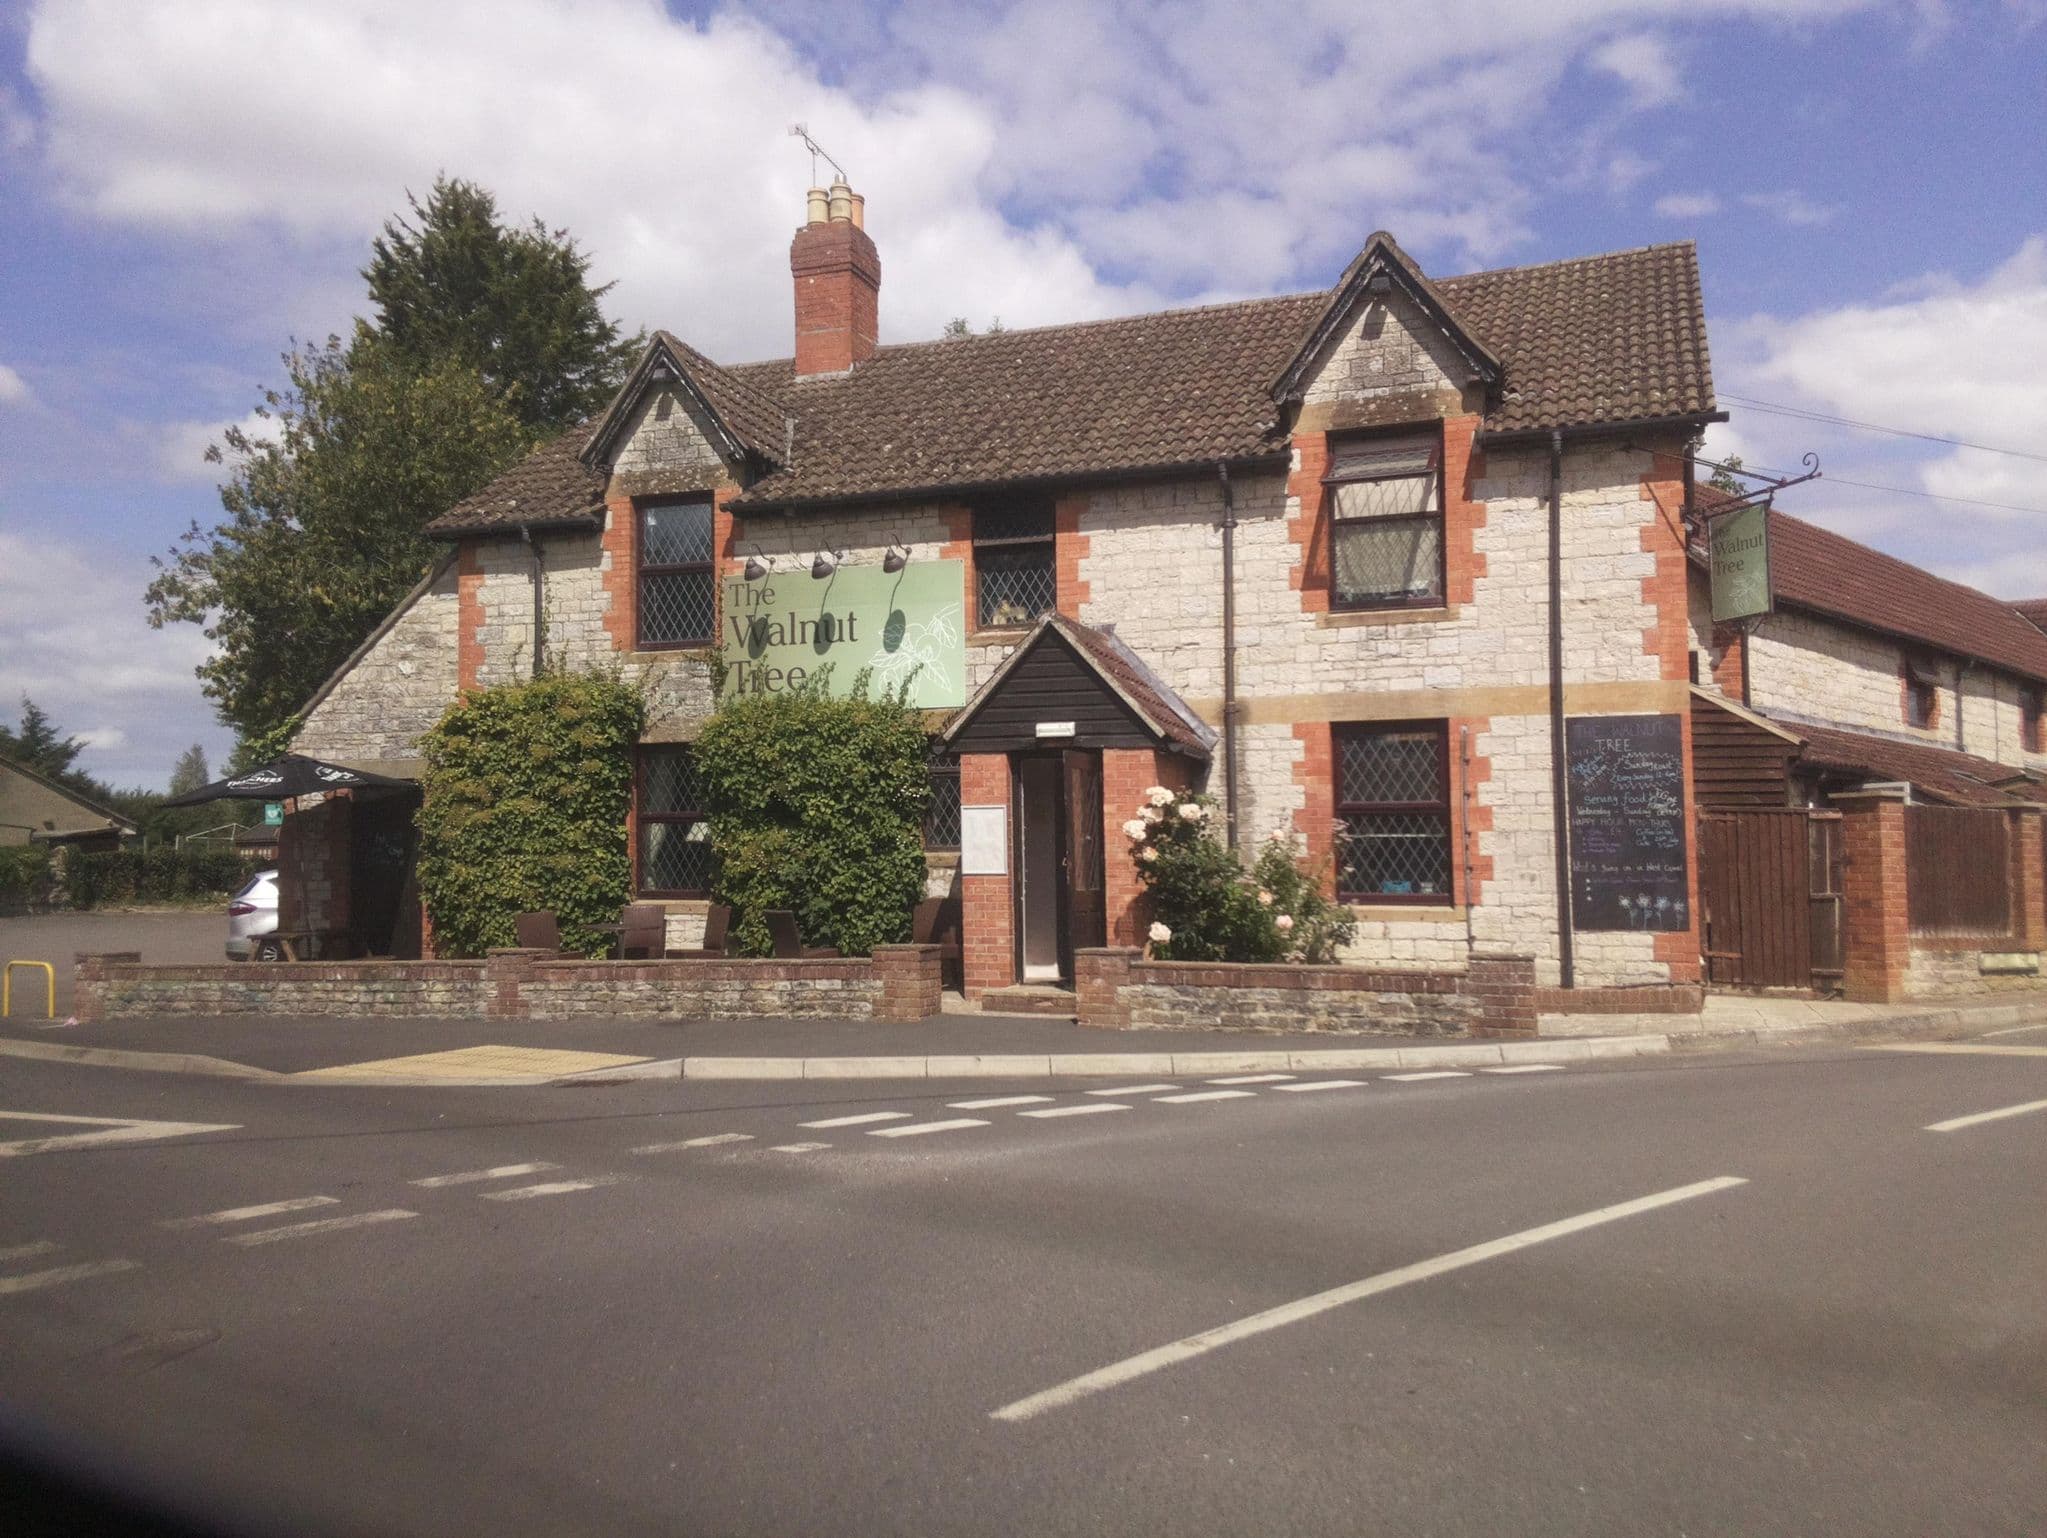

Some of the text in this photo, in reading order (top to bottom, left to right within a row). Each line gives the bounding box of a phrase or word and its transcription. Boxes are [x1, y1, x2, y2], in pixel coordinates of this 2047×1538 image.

[1713, 533, 1763, 557] Walnut
[1713, 559, 1745, 577] Tree
[729, 583, 776, 607] The
[729, 611, 859, 649] Walnut
[728, 659, 807, 694] Tree
[1594, 738, 1632, 753] TREE
[1621, 791, 1648, 806] food
